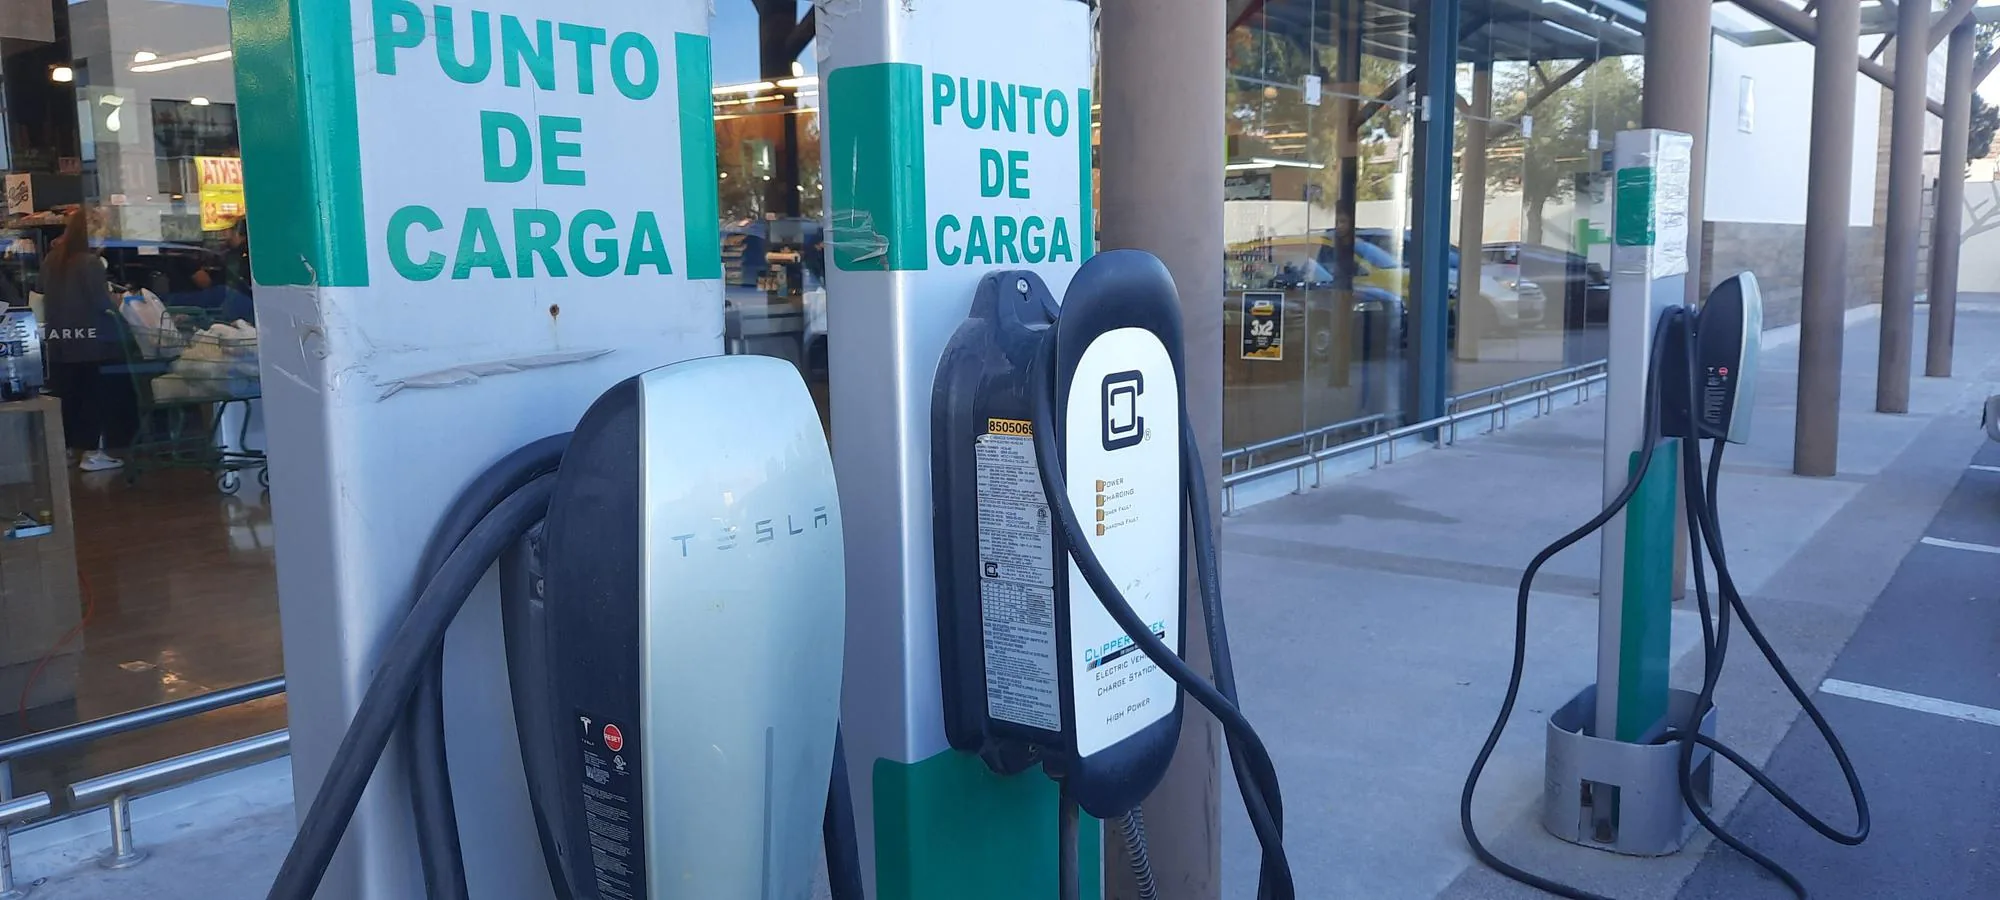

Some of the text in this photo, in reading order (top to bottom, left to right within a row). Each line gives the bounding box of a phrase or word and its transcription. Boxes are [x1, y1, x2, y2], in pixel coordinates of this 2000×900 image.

[371, 0, 659, 100] PUNTO
[99, 94, 124, 132] 7
[932, 73, 1069, 137] PUNTO
[480, 110, 586, 186] DE
[980, 148, 1030, 199] DE
[386, 205, 673, 282] CARGA
[935, 214, 1073, 266] CARGA
[671, 505, 828, 557] TESLA
[1084, 620, 1165, 662] CLIPPEREK
[1095, 661, 1129, 681] ELECTRIC
[1097, 664, 1157, 697] CHARGE STATION
[1106, 697, 1151, 724] HIGH POWER
